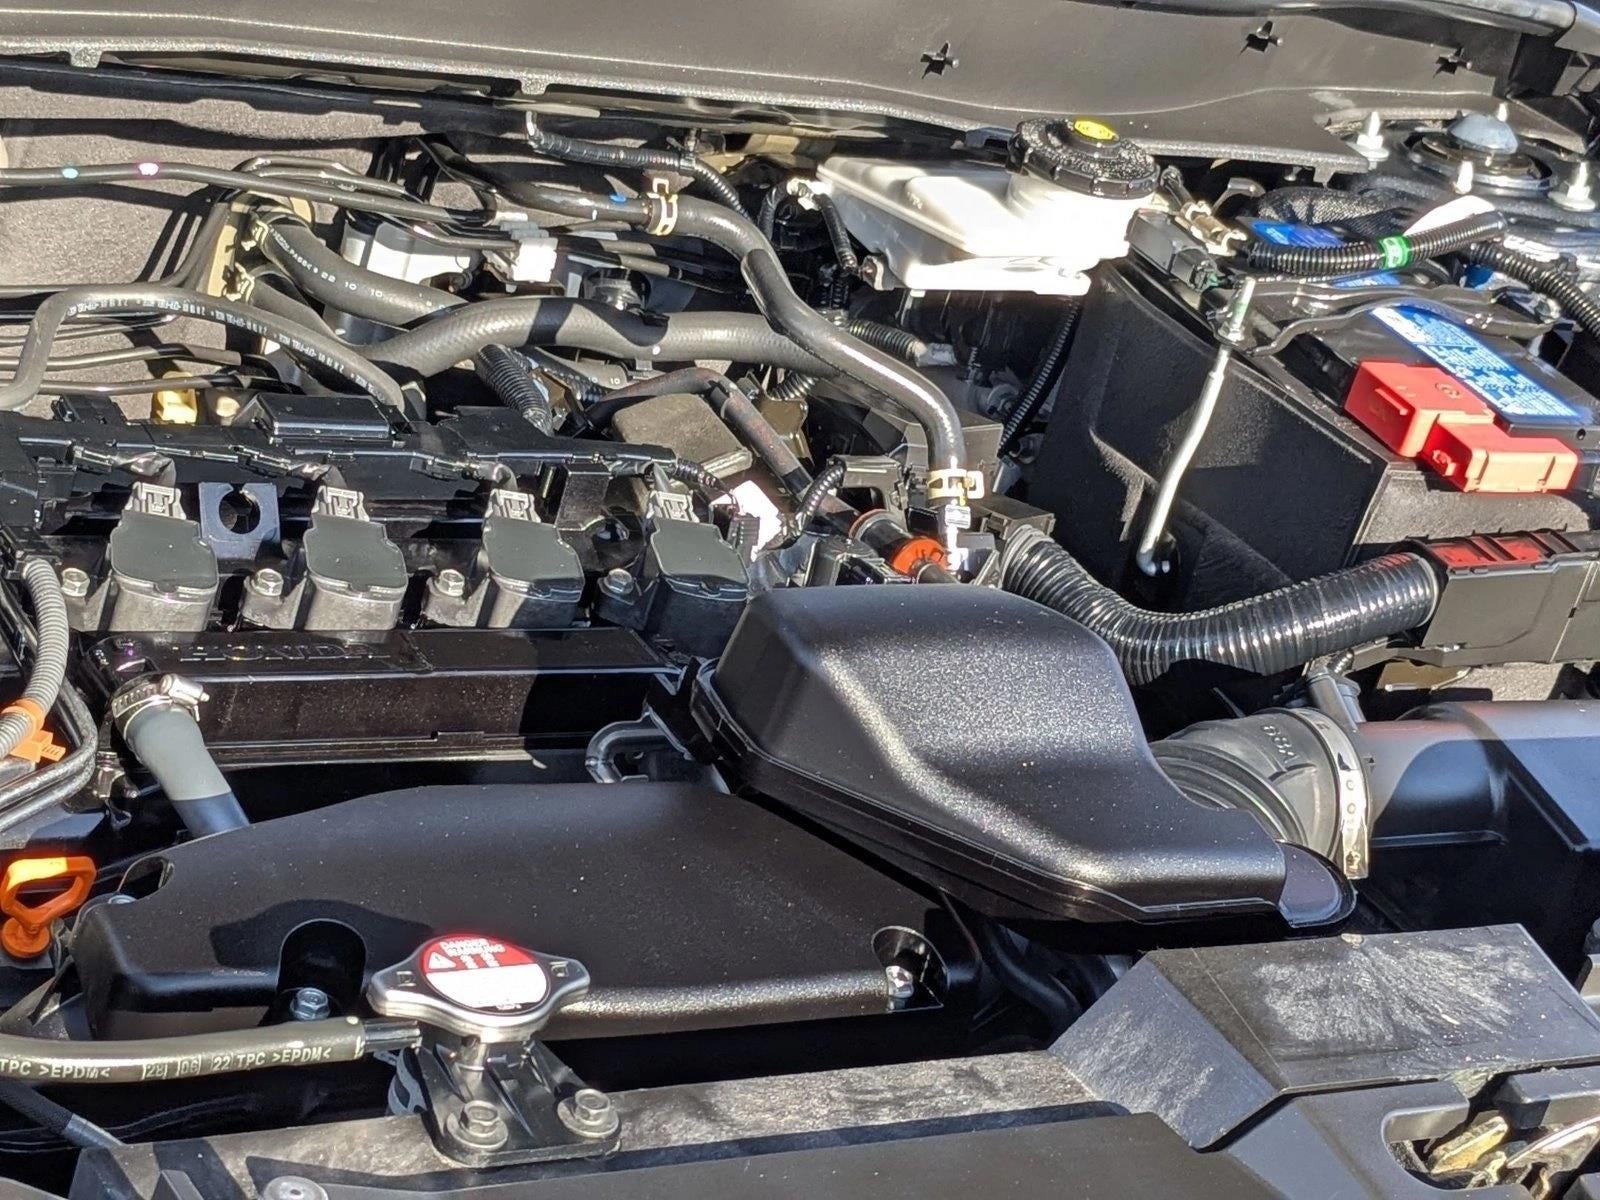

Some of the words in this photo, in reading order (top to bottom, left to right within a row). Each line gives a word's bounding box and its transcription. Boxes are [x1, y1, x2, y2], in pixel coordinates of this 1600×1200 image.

[610, 377, 621, 385] 10
[173, 643, 391, 661] HONDA
[236, 1053, 267, 1069] TPC
